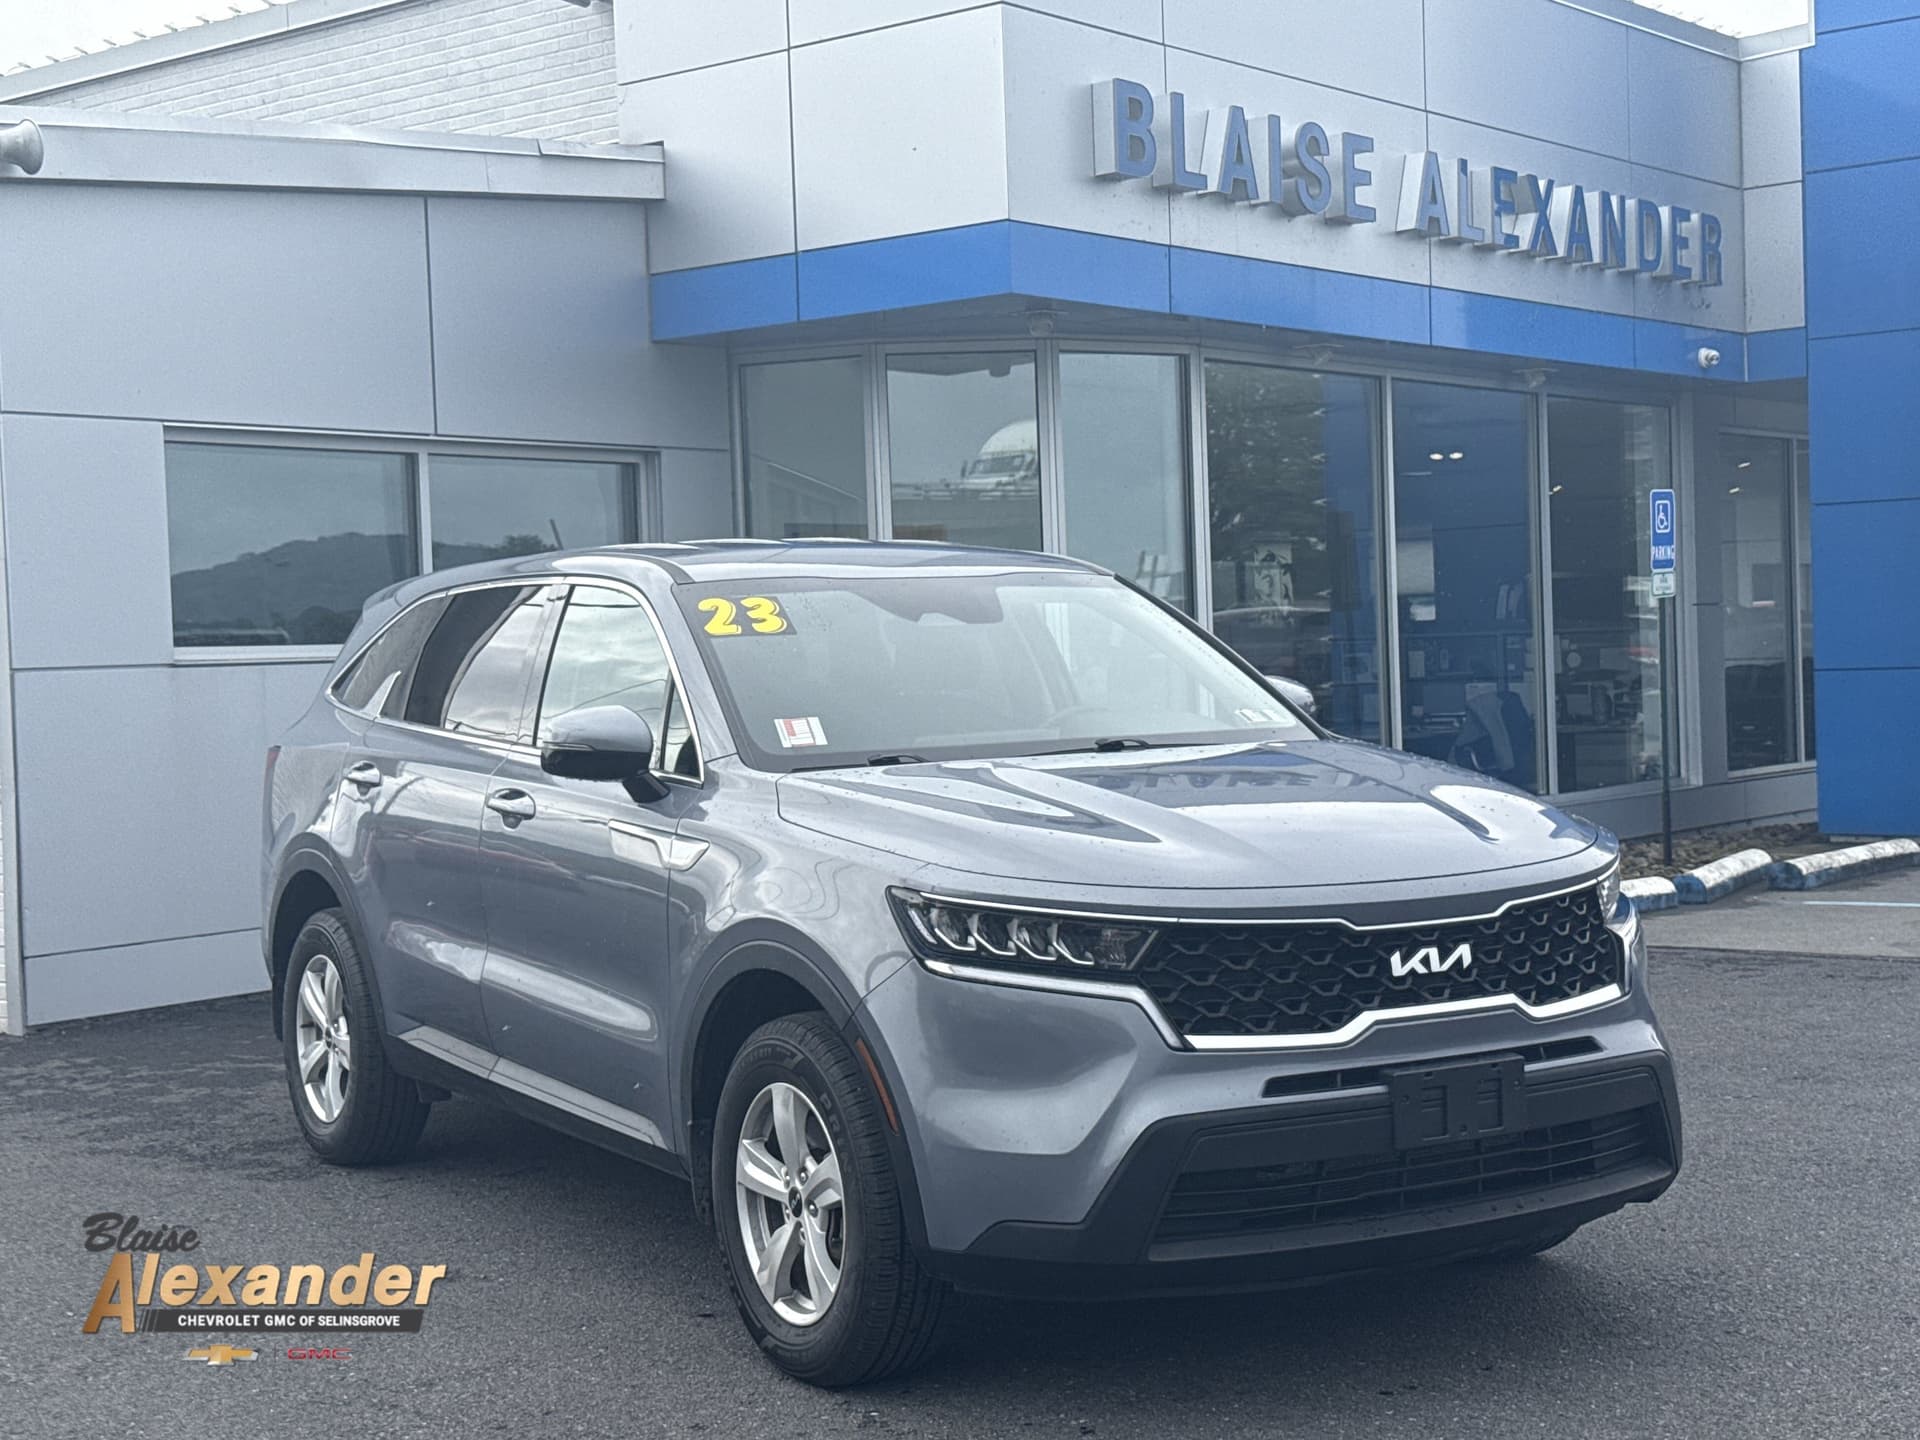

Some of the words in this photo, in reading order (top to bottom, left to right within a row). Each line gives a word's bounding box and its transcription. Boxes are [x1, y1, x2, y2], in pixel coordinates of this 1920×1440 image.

[1110, 77, 1377, 223] BLAISE
[1412, 150, 1723, 287] ALEXANDER
[1652, 544, 1675, 560] PARKING
[697, 596, 788, 636] 23
[1390, 943, 1472, 977] KIA
